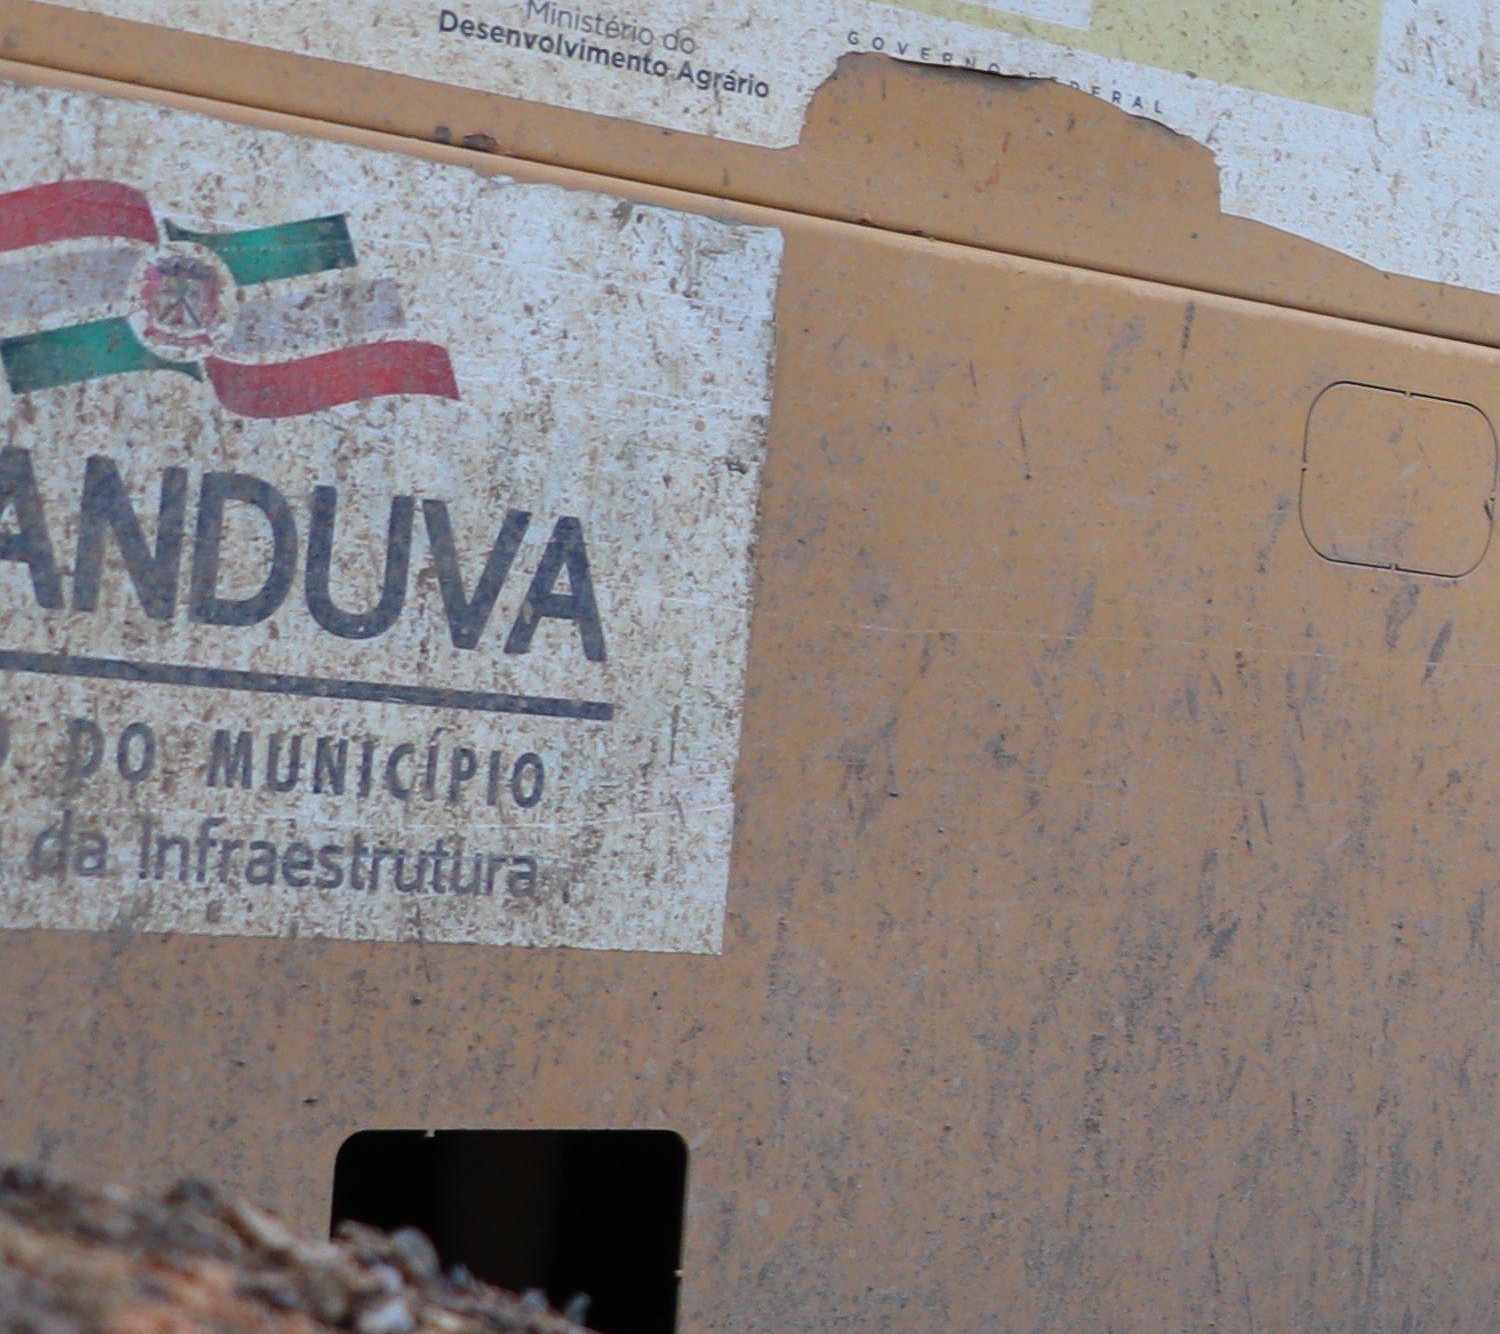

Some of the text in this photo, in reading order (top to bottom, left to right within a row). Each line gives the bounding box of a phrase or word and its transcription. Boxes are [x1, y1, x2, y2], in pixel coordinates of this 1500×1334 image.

[438, 9, 770, 99] Desenvolvimento Agrário
[662, 26, 697, 55] do
[1028, 71, 1163, 114] DERAL
[0, 446, 607, 662] ANDUVA
[66, 718, 155, 782] DO
[206, 726, 545, 808] MUNICÍPIO
[29, 809, 538, 897] da Infraestrutura
